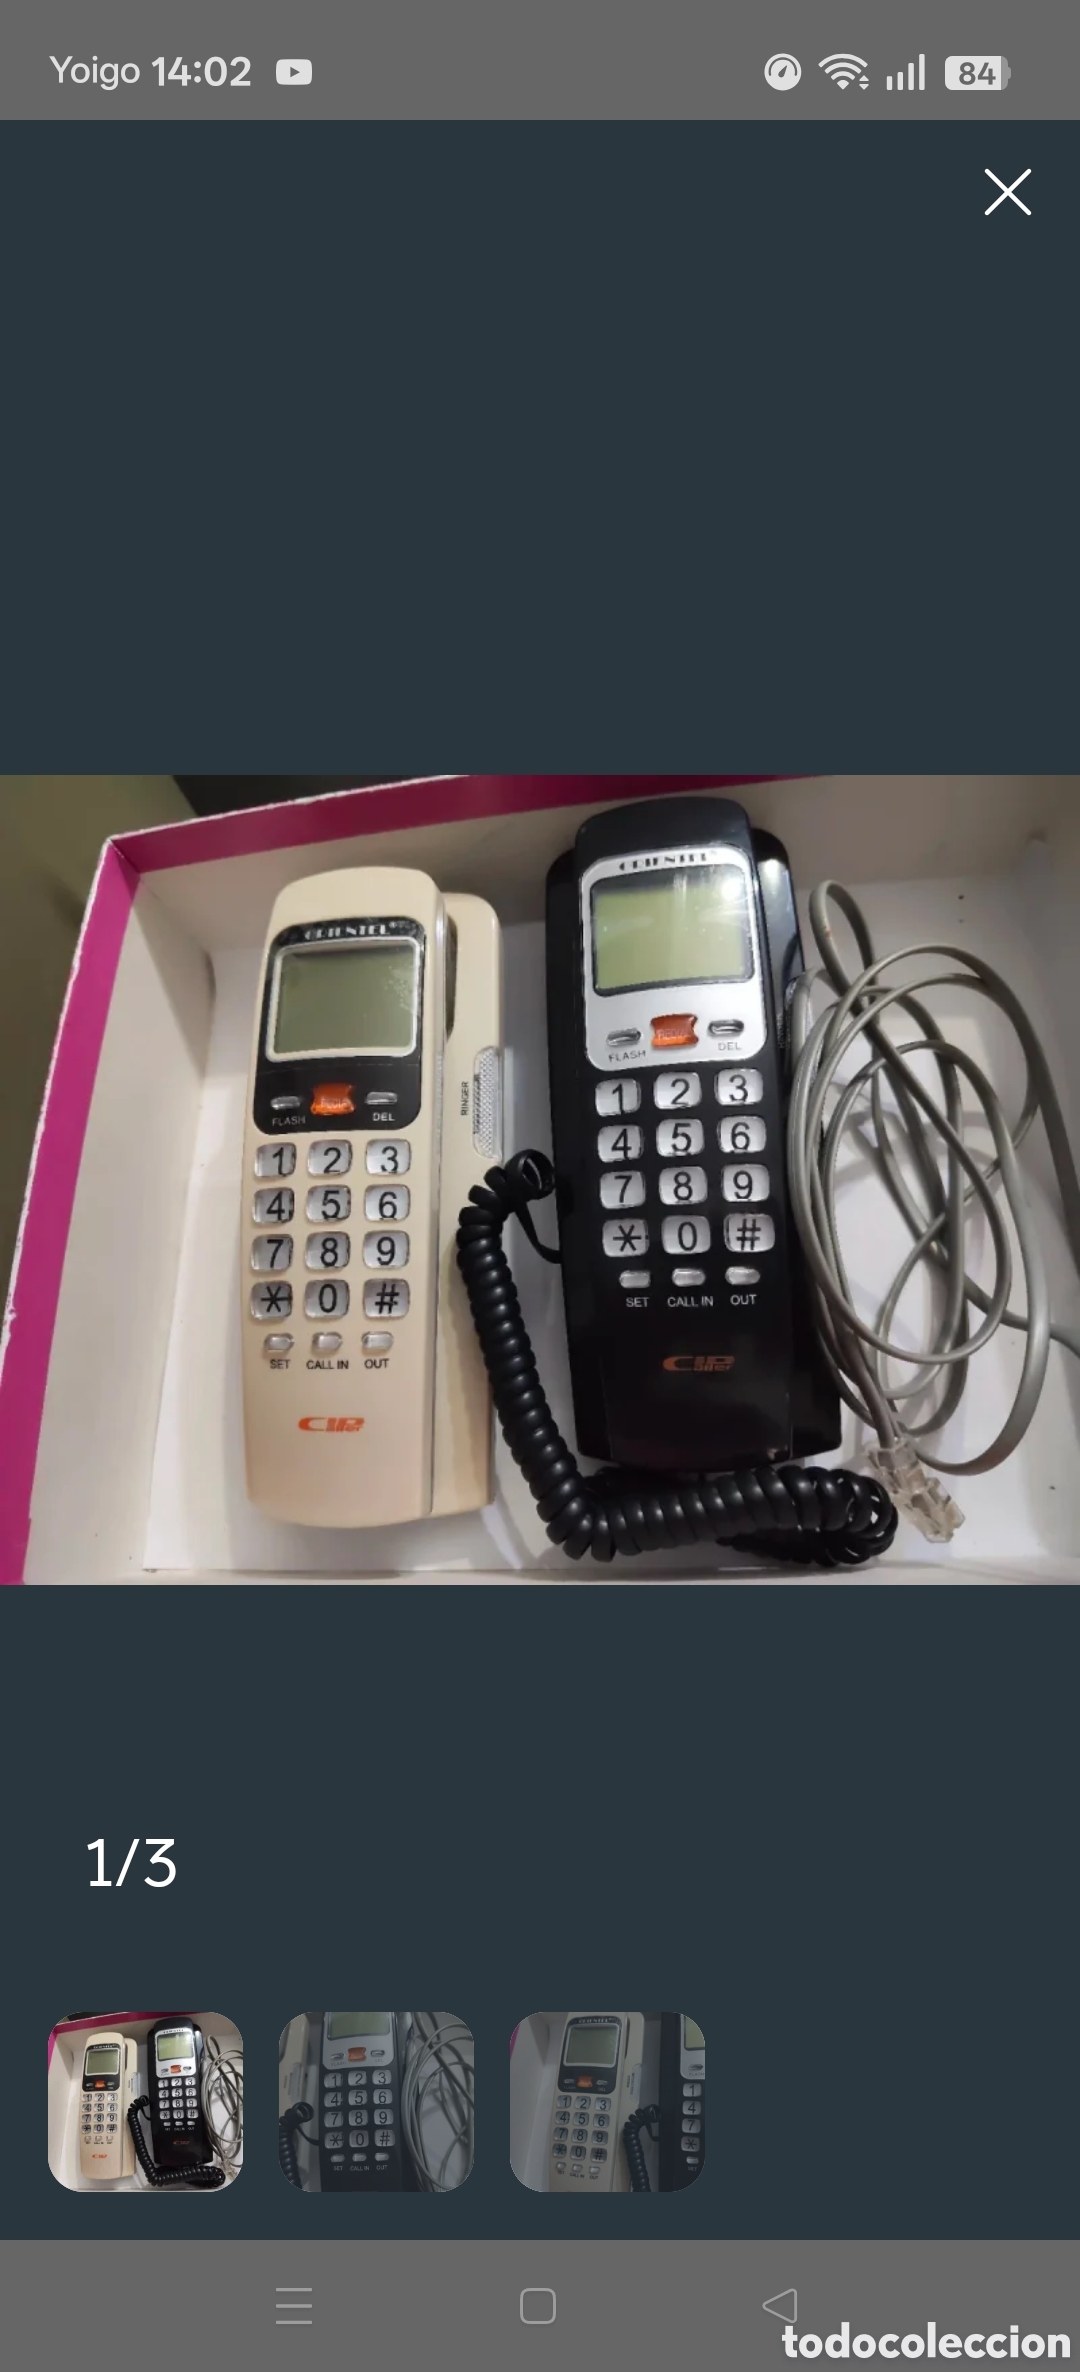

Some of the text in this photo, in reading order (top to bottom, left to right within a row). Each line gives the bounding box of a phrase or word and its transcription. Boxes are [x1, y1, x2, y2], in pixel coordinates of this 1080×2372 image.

[49, 55, 251, 91] Yoigo 14:02
[958, 61, 996, 86] 84
[718, 1042, 742, 1052] DEL
[608, 1050, 647, 1062] FLASH
[461, 1081, 470, 1116] RINGER
[612, 1074, 749, 1114] 1 2 3
[271, 1115, 305, 1127] FLASH
[372, 1112, 395, 1122] DEL
[612, 1122, 750, 1159] 4 5 6
[272, 1146, 399, 1177] 1 2 3
[614, 1170, 753, 1204] 7 8 9
[266, 1190, 398, 1222] 4 5 6
[677, 1221, 698, 1251] 0
[736, 1218, 762, 1251] #
[266, 1236, 396, 1269] 7 8 9
[318, 1283, 338, 1313] 0
[374, 1283, 400, 1315] #
[626, 1297, 649, 1308] SET
[667, 1296, 714, 1308] CALL IN
[730, 1294, 757, 1305] OUT
[269, 1359, 291, 1370] SET
[306, 1360, 349, 1370] CALL IN
[364, 1358, 389, 1369] OUT
[86, 1838, 177, 1888] 1/3
[332, 2071, 386, 2087] 1 2 3
[689, 2084, 695, 2096] 1
[330, 2091, 387, 2107] 4 5 6
[563, 2096, 607, 2111] 1 2 3
[687, 2102, 696, 2114] 4
[330, 2111, 388, 2126] 7 8 9
[559, 2112, 605, 2127] 4 5 6
[687, 2119, 696, 2131] 7
[355, 2132, 365, 2146] 0
[379, 2131, 391, 2147] #
[559, 2128, 604, 2143] 7 8 9
